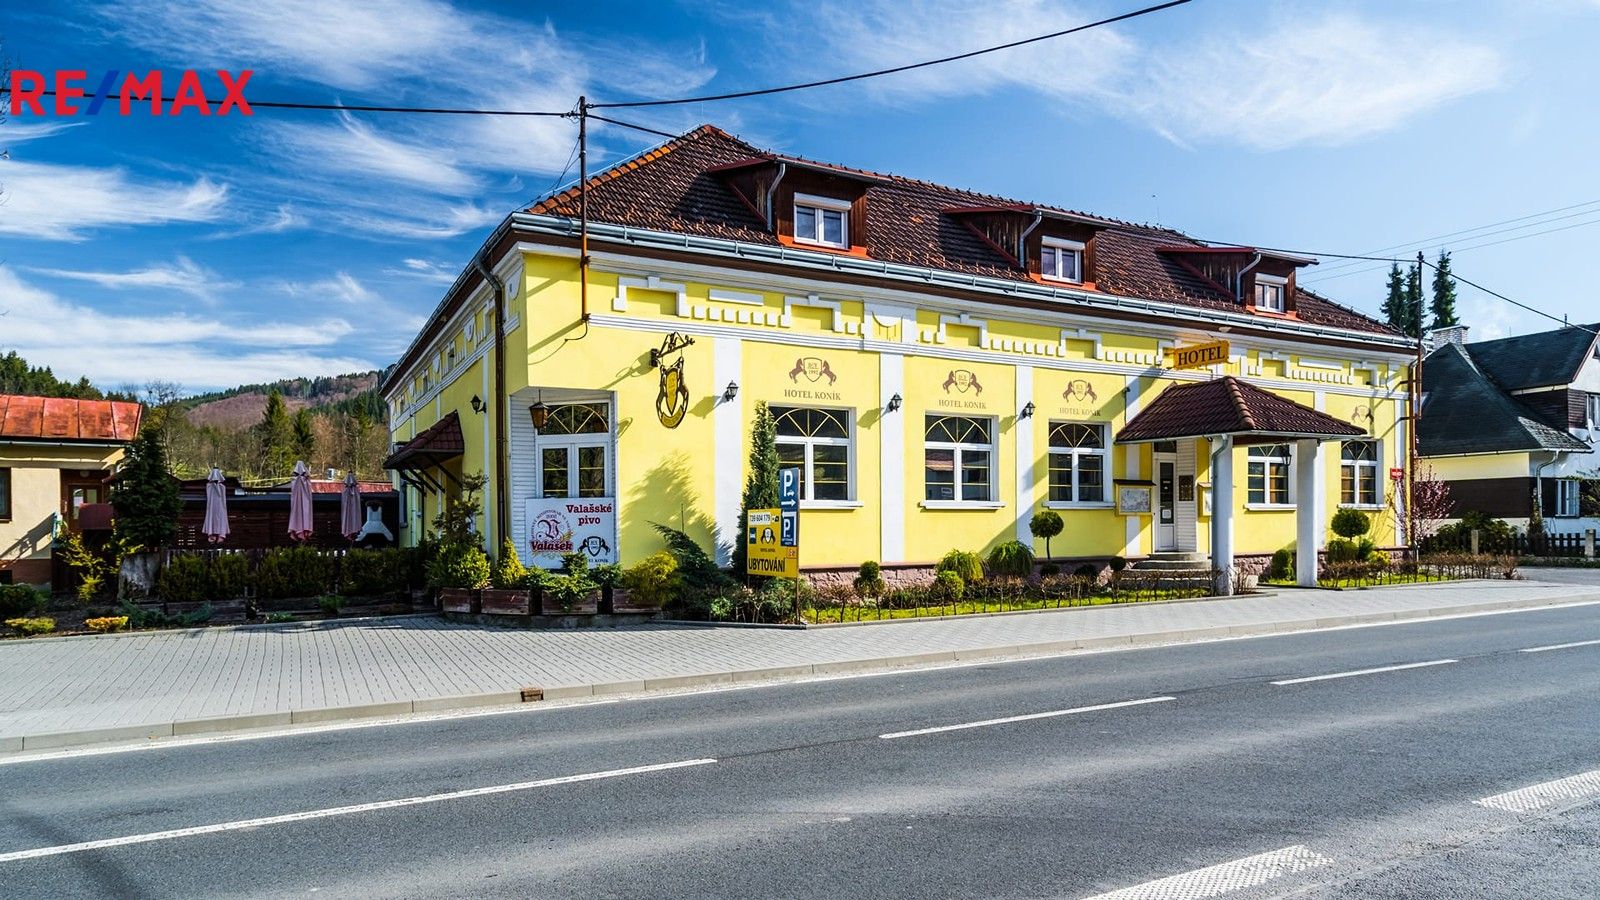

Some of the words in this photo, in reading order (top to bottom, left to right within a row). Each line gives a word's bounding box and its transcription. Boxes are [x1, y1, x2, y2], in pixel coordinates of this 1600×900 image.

[1178, 346, 1225, 366] HOTEL
[784, 389, 813, 399] HOTEL
[814, 390, 842, 401] KONÍK
[938, 400, 963, 408] HOTEL
[1059, 407, 1080, 415] HOTEL
[784, 470, 793, 497] P
[566, 503, 612, 513] Valašské
[578, 515, 601, 527] pivo
[783, 518, 791, 537] P
[748, 557, 786, 573] UBYTOVÁNÍ
